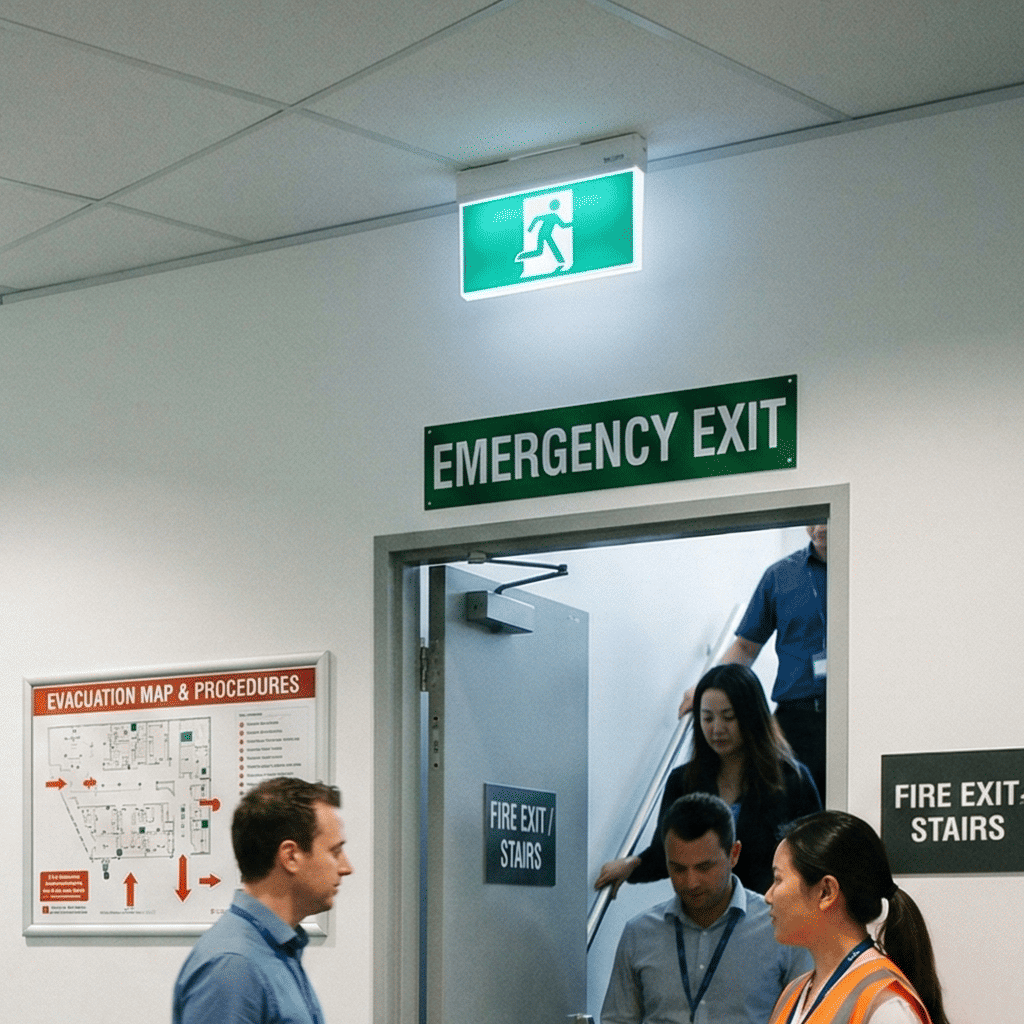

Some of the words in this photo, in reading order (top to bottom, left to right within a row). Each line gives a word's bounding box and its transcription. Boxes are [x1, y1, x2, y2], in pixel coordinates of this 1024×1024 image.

[433, 411, 679, 490] EMERGENCY
[693, 397, 787, 458] EXIT
[47, 686, 136, 711] EVACUATION
[140, 684, 174, 705] MAP
[178, 682, 189, 702] &
[194, 674, 300, 700] PROCEDURES
[894, 782, 952, 809] FIRE
[961, 780, 1020, 807] EXIT
[490, 800, 517, 831] FIRE
[520, 804, 547, 834] EXIT
[547, 807, 554, 837] /
[910, 814, 1005, 842] STAIRS
[500, 838, 542, 870] STAIRS
